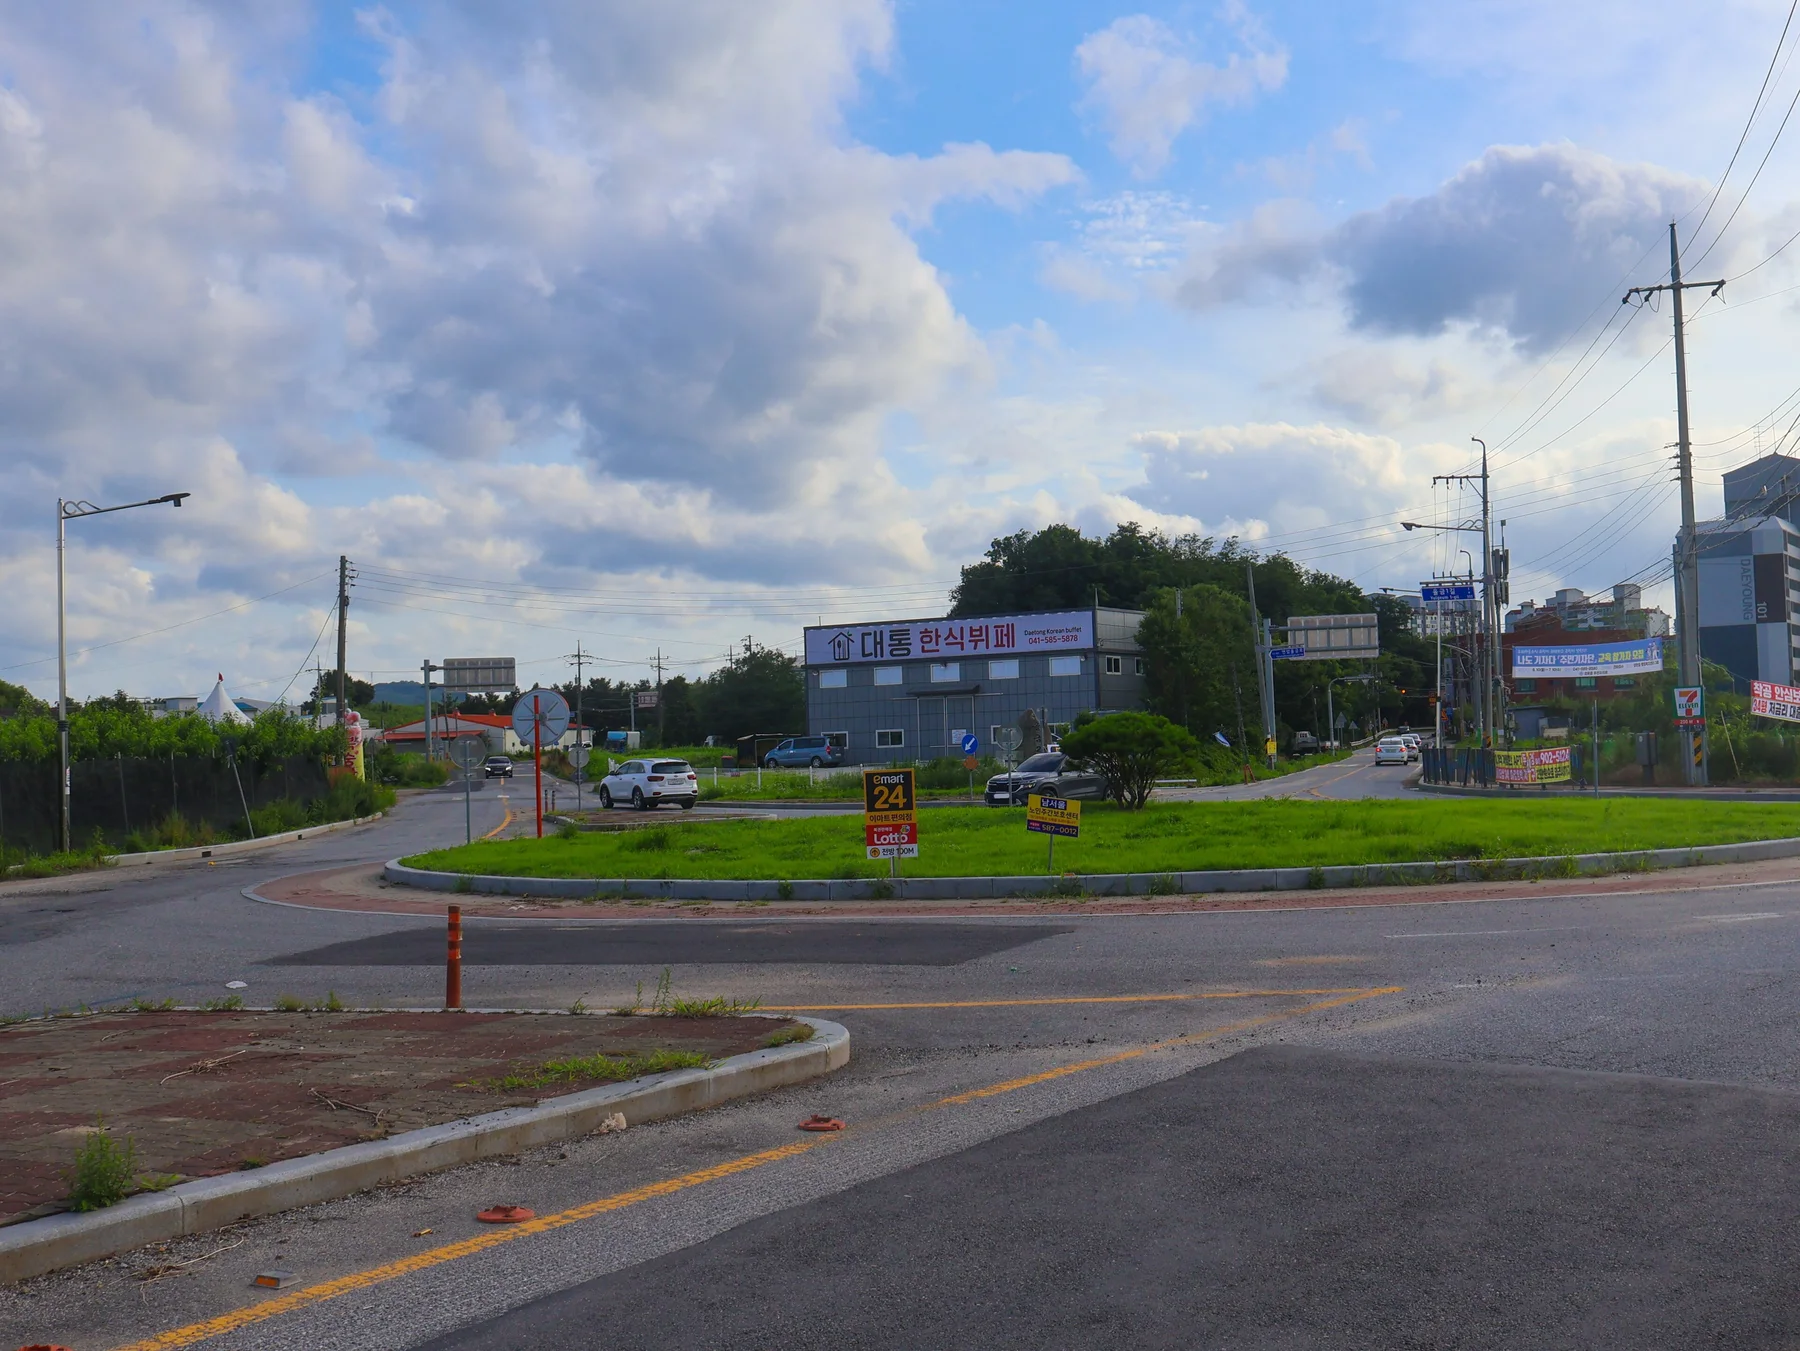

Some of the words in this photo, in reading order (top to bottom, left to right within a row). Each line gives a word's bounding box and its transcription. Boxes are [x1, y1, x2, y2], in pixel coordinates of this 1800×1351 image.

[1740, 558, 1754, 620] DAEYOUNG
[1757, 601, 1768, 619] 101
[1024, 629, 1046, 637] Daetong
[860, 628, 912, 659] 대통
[918, 622, 1016, 654] 한식뷔페
[1028, 634, 1078, 645] 041-585-5878
[1517, 655, 1533, 665] 나도
[1534, 655, 1557, 665] 기자다
[1753, 682, 1772, 699] 착공
[1679, 690, 1698, 716] 7
[1753, 698, 1768, 714] 34평
[1768, 701, 1788, 717] 저금리
[873, 774, 904, 785] emart
[873, 784, 907, 809] 24
[1041, 798, 1066, 810] 남서울
[869, 814, 890, 823] 이마트
[891, 813, 912, 822] 편의점
[1029, 806, 1079, 820] 노인주간보호센터
[1041, 823, 1077, 835] 587-0012
[873, 832, 908, 844] Lotto
[881, 847, 895, 856] 전방
